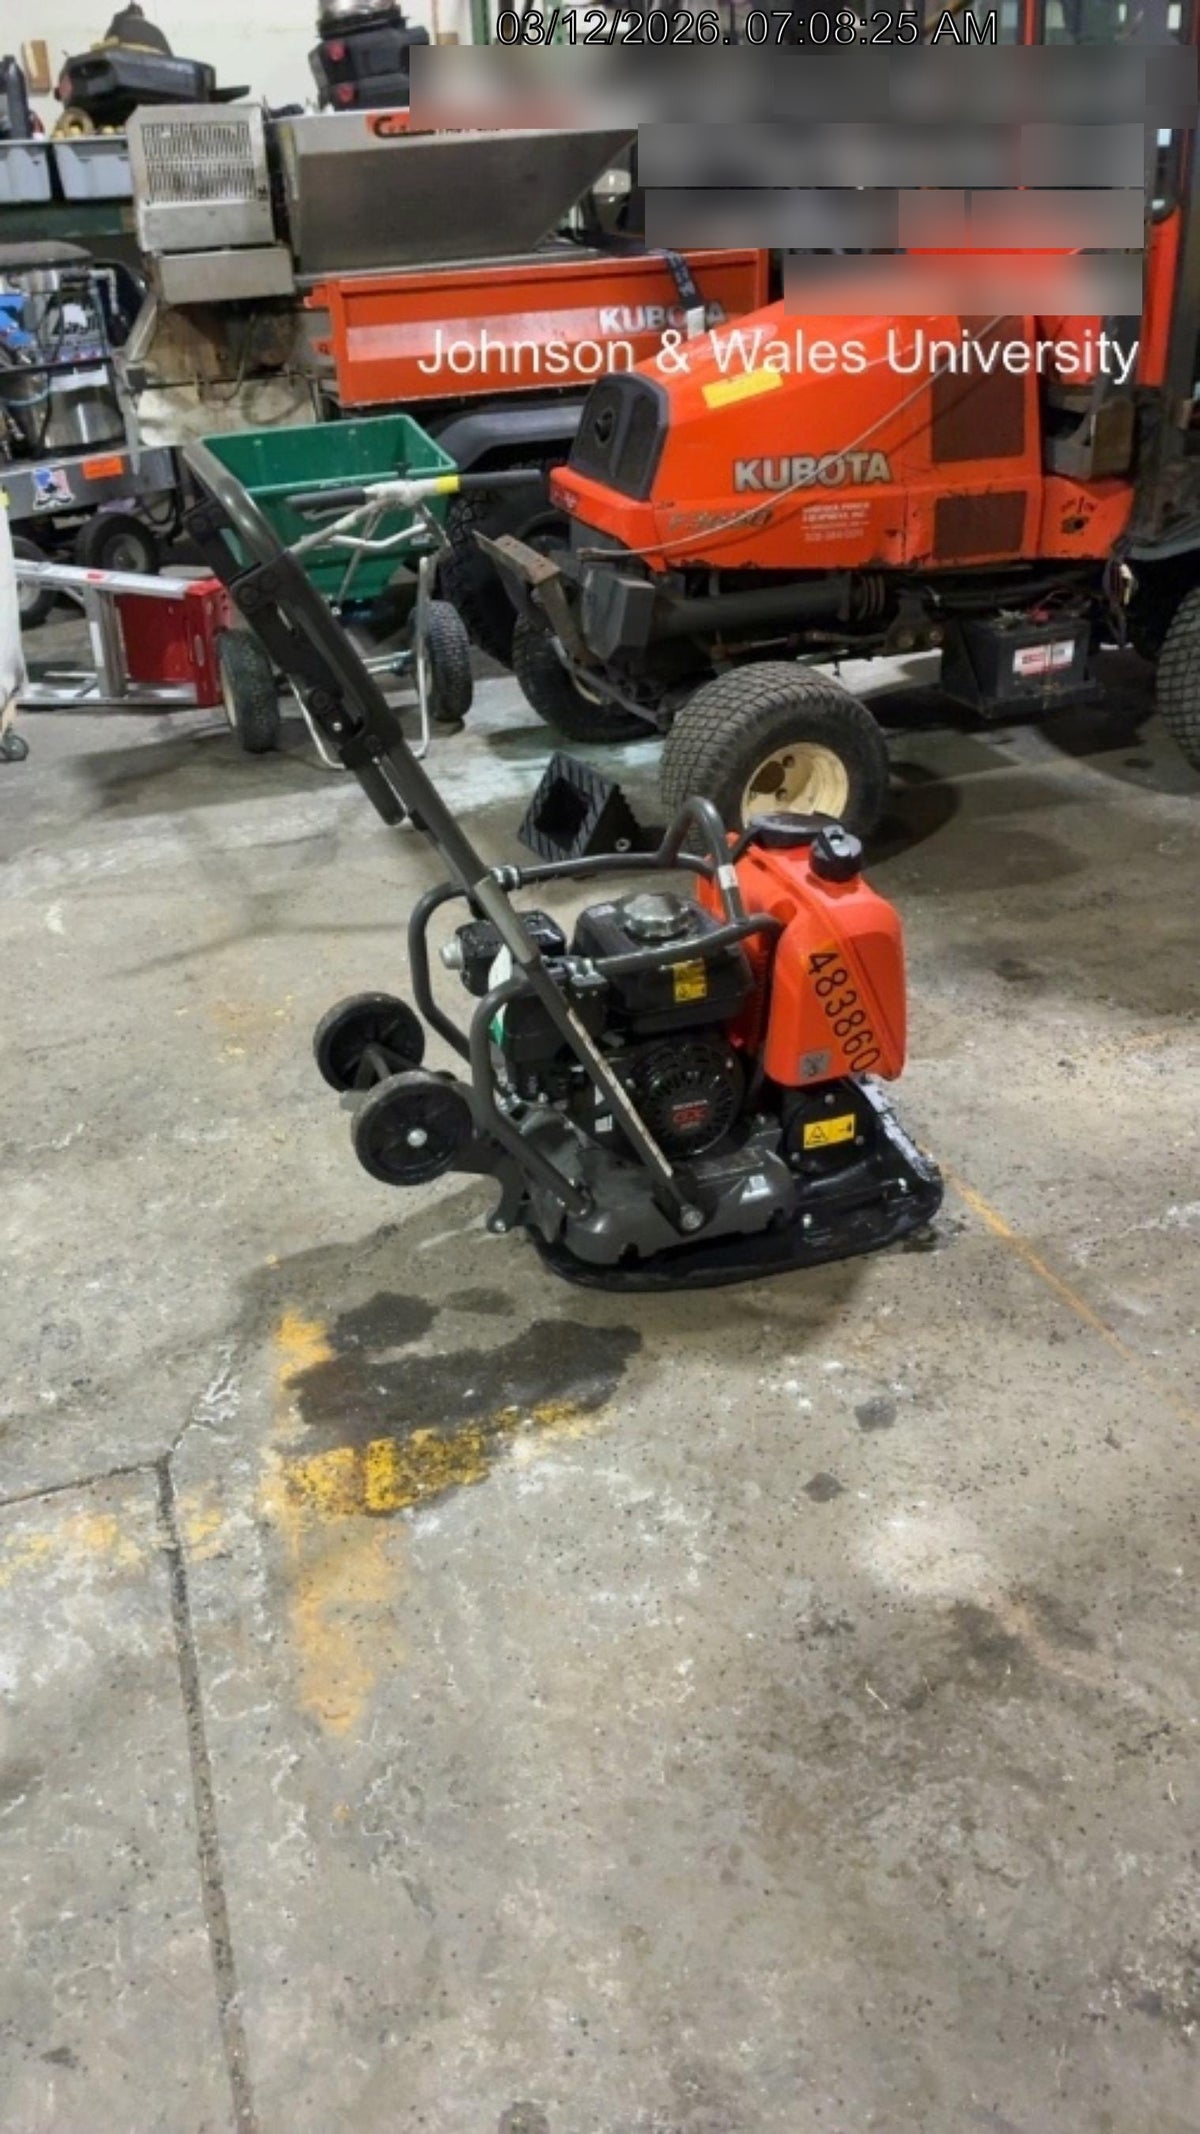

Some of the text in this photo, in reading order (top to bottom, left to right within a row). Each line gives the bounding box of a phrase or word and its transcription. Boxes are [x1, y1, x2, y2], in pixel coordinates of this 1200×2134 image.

[598, 301, 727, 335] KUBOA
[733, 451, 893, 492] KUBOTA
[808, 952, 881, 1073] 483860
